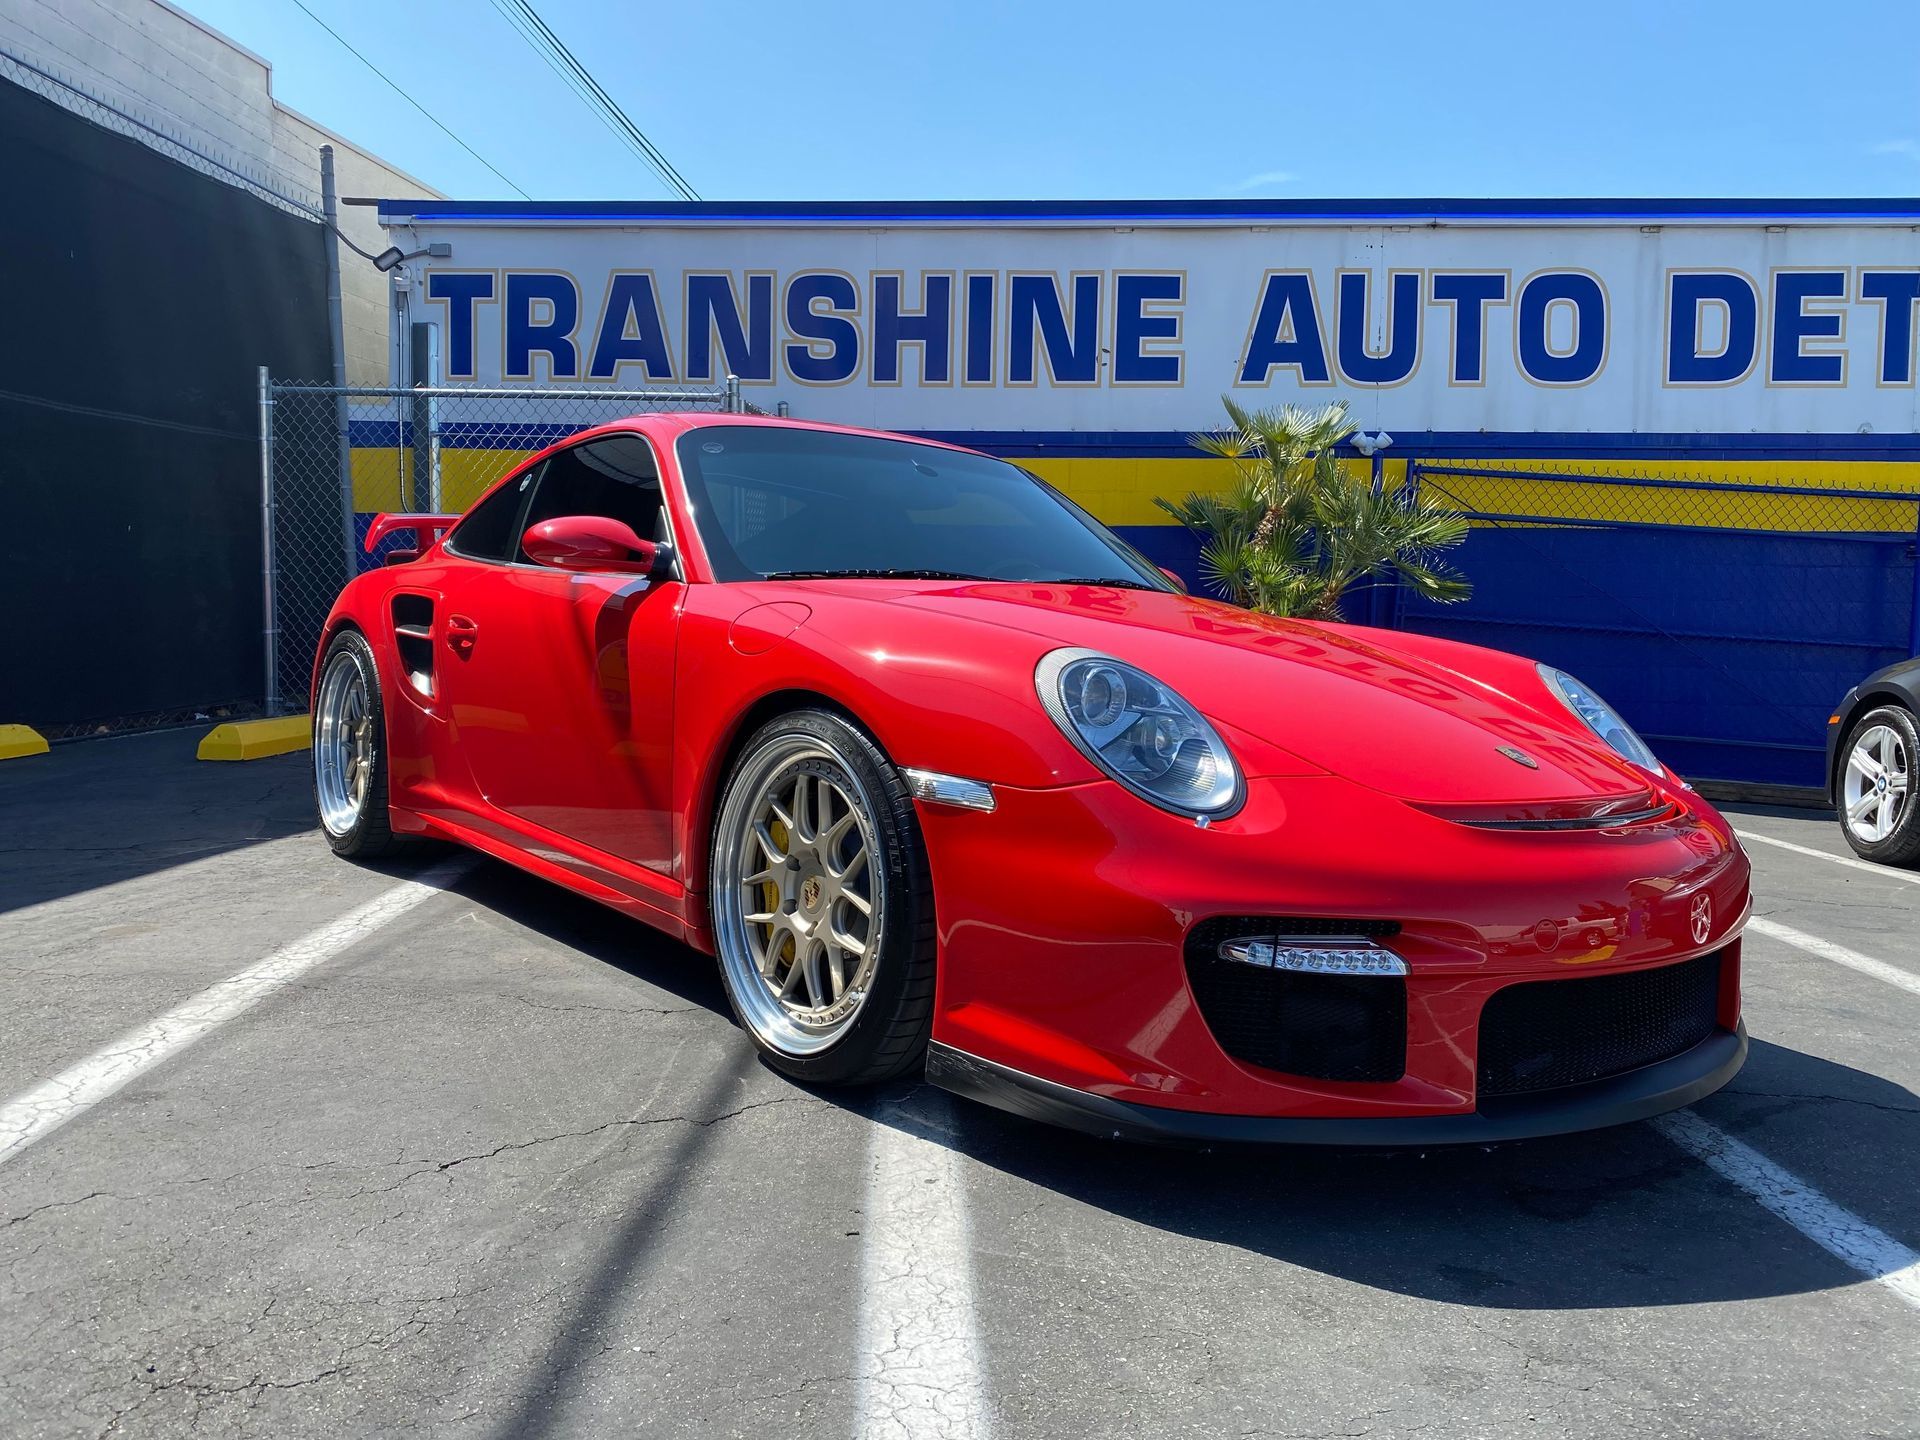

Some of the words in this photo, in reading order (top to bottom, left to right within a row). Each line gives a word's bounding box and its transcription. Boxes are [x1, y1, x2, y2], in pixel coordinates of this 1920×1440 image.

[424, 268, 1187, 388] TRANSHINE
[1233, 267, 1611, 389] AUTO
[1663, 266, 1920, 388] DET
